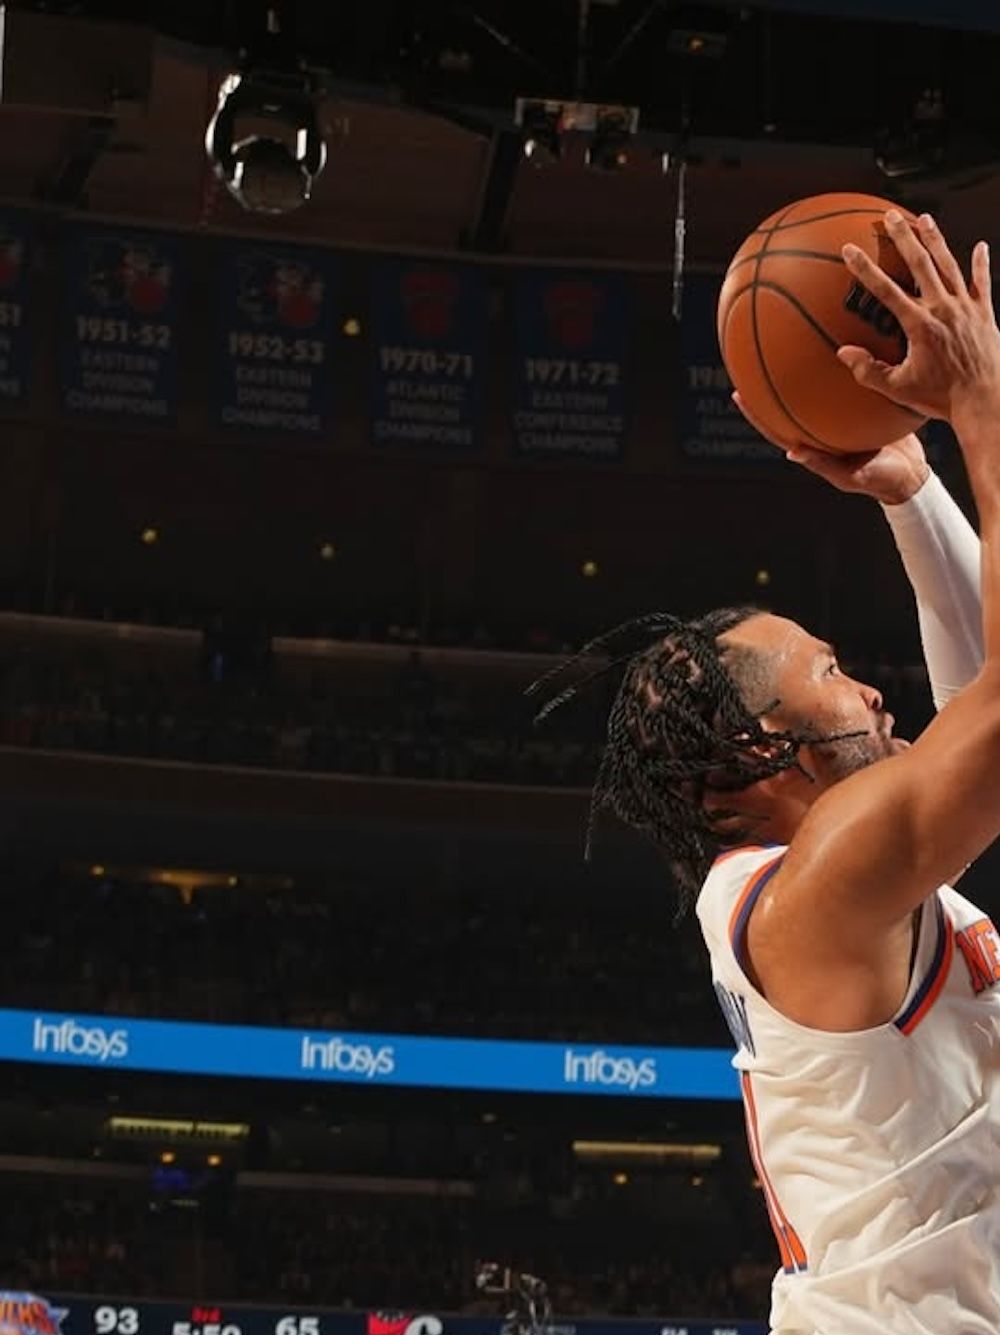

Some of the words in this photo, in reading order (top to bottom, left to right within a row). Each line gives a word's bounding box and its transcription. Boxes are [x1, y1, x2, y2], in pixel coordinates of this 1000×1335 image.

[76, 315, 171, 348] 1951-52
[229, 331, 325, 364] 1952-53
[379, 345, 473, 379] 1970-71
[32, 1018, 128, 1061] Infosys
[302, 1037, 395, 1077] Infosys
[564, 1050, 657, 1089] Infosys
[94, 1306, 140, 1335] 93
